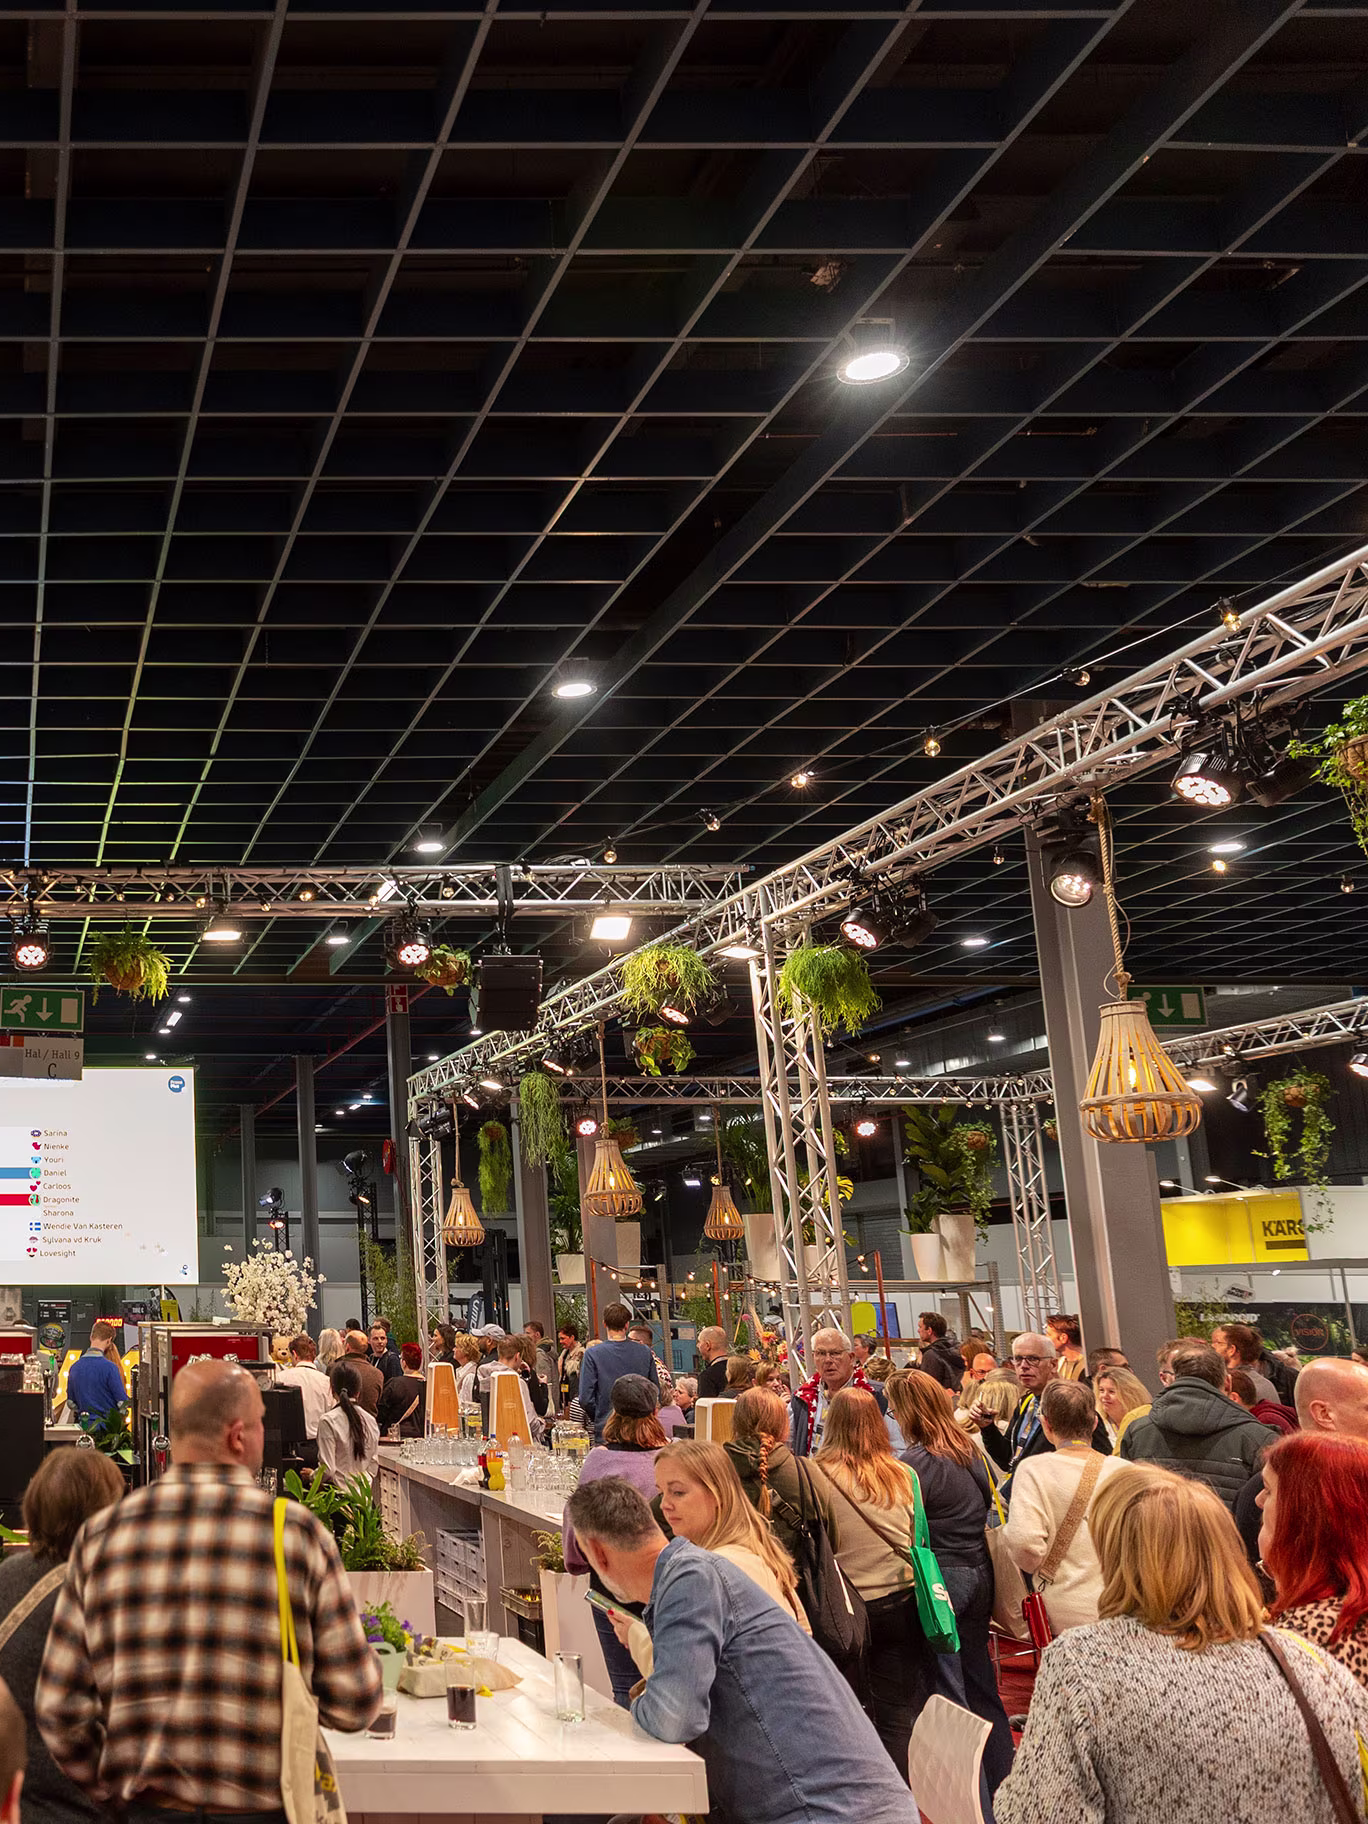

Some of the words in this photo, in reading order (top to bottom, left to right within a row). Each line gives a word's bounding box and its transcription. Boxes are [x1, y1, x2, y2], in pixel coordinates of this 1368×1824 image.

[25, 1048, 41, 1058] Hal
[42, 1048, 48, 1060] /
[52, 1050, 71, 1060] Hall
[74, 1051, 80, 1060] 9
[48, 1062, 57, 1078] C
[43, 1196, 80, 1205] Dragonite
[42, 1236, 72, 1244] Sylvana
[40, 1250, 76, 1258] Lovesight
